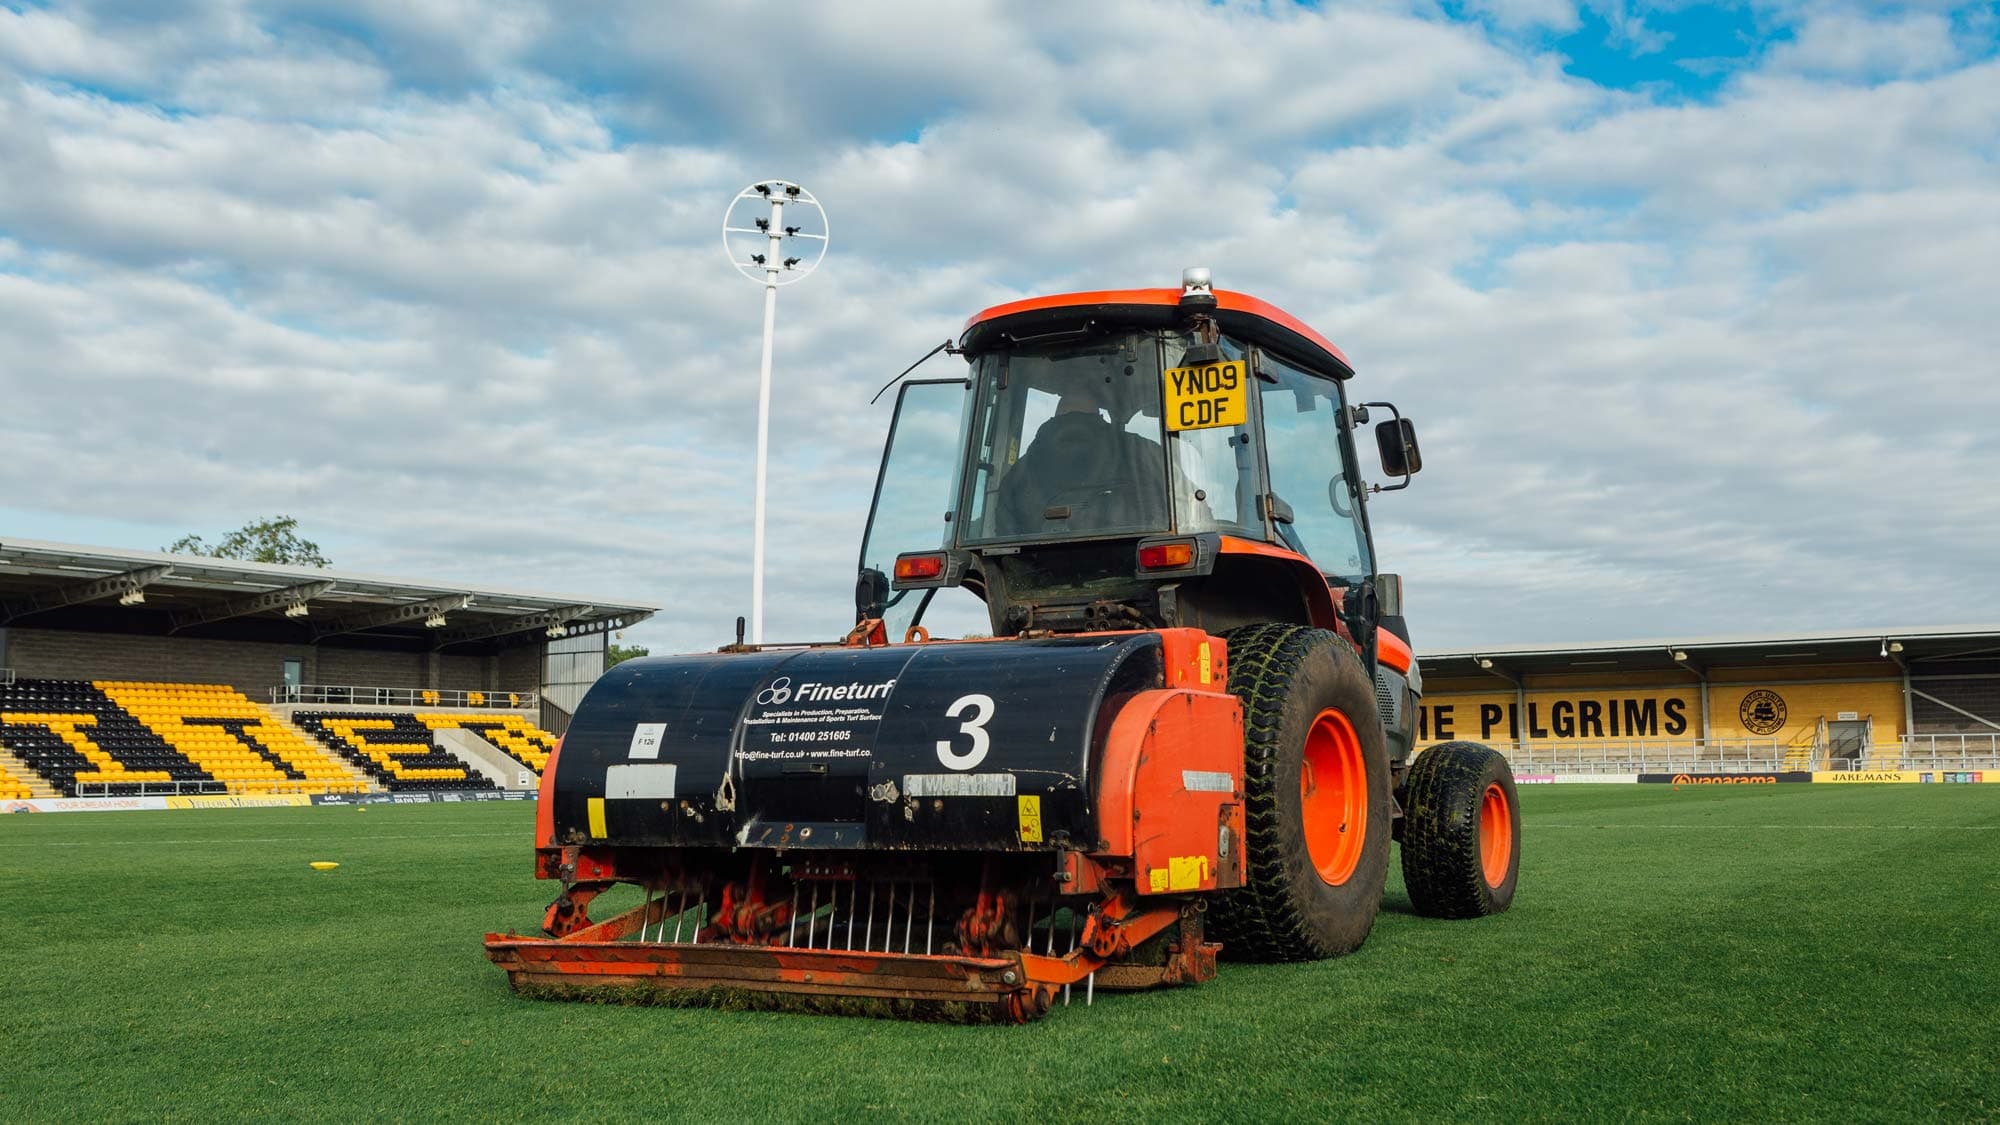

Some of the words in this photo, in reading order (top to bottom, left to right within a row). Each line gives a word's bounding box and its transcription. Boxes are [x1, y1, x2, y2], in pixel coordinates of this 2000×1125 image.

[1171, 365, 1237, 396] YN09
[1180, 397, 1229, 426] CDF
[794, 679, 898, 702] Fineturf
[936, 693, 995, 771] 3
[1480, 698, 1687, 740] PILGRIMS
[770, 732, 786, 742] Tel:
[788, 732, 815, 742] 01400
[817, 731, 851, 741] 251605
[1832, 773, 1901, 781] JAKEMANS
